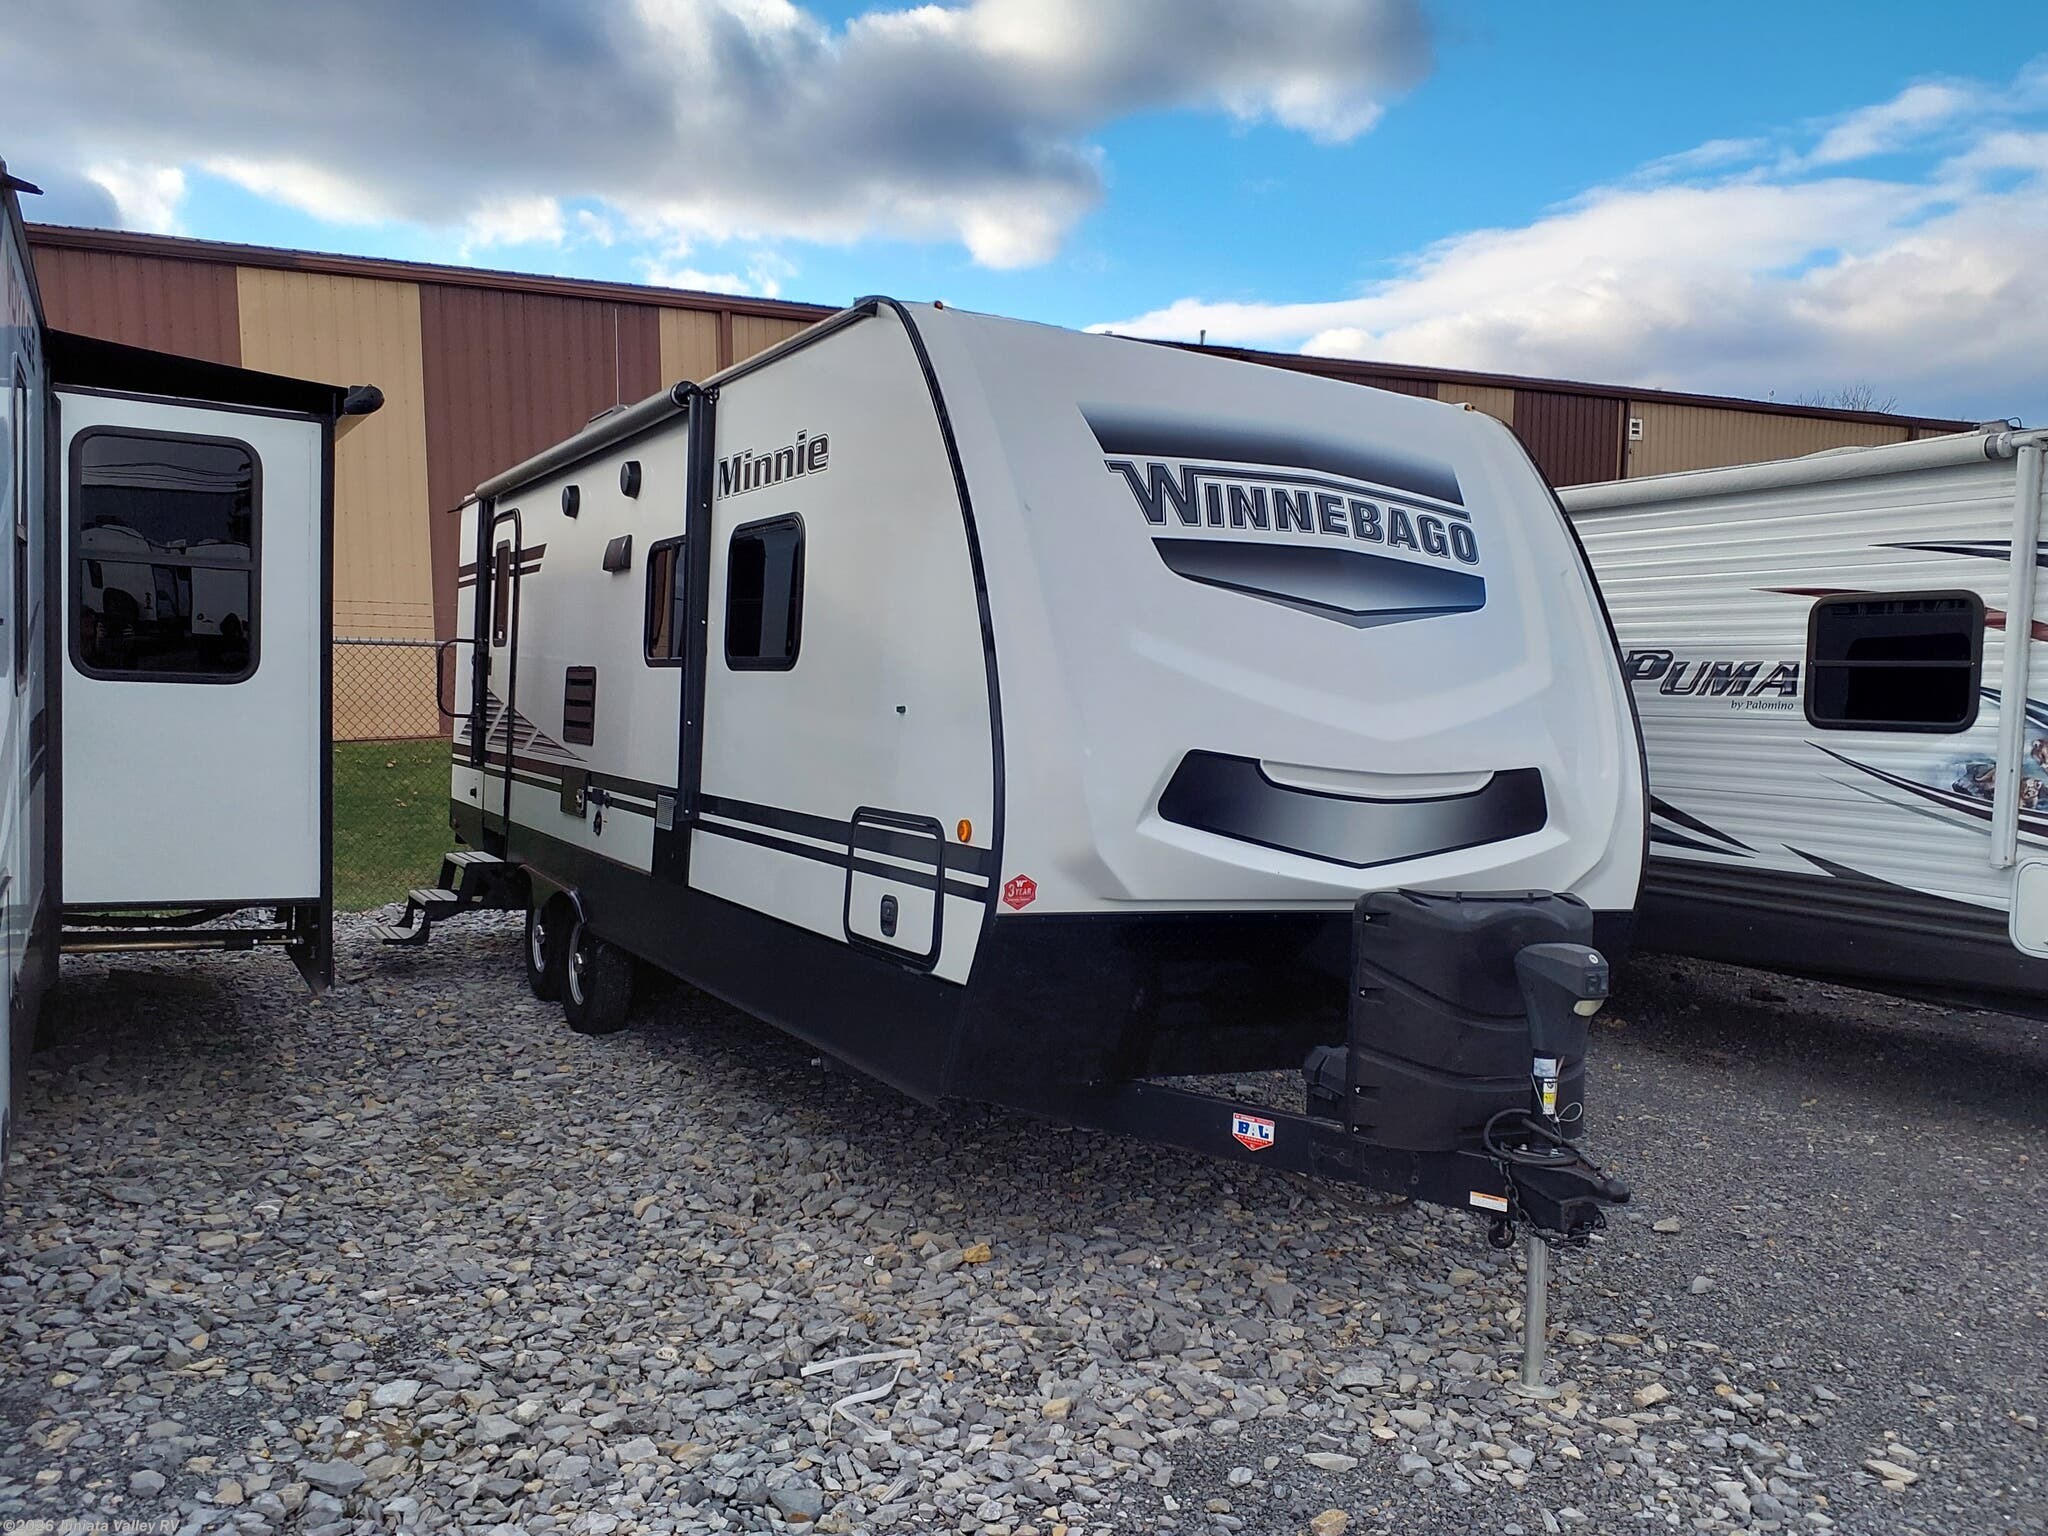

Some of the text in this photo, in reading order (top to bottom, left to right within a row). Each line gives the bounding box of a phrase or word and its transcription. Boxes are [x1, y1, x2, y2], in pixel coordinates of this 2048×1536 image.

[717, 429, 829, 500] Minnie
[1104, 460, 1480, 566] WINNEBAGO
[1626, 650, 1799, 697] PUMA
[1731, 700, 1794, 710] by Palomino
[1007, 884, 1032, 897] 3 YEAR
[1237, 1120, 1269, 1139] BAL
